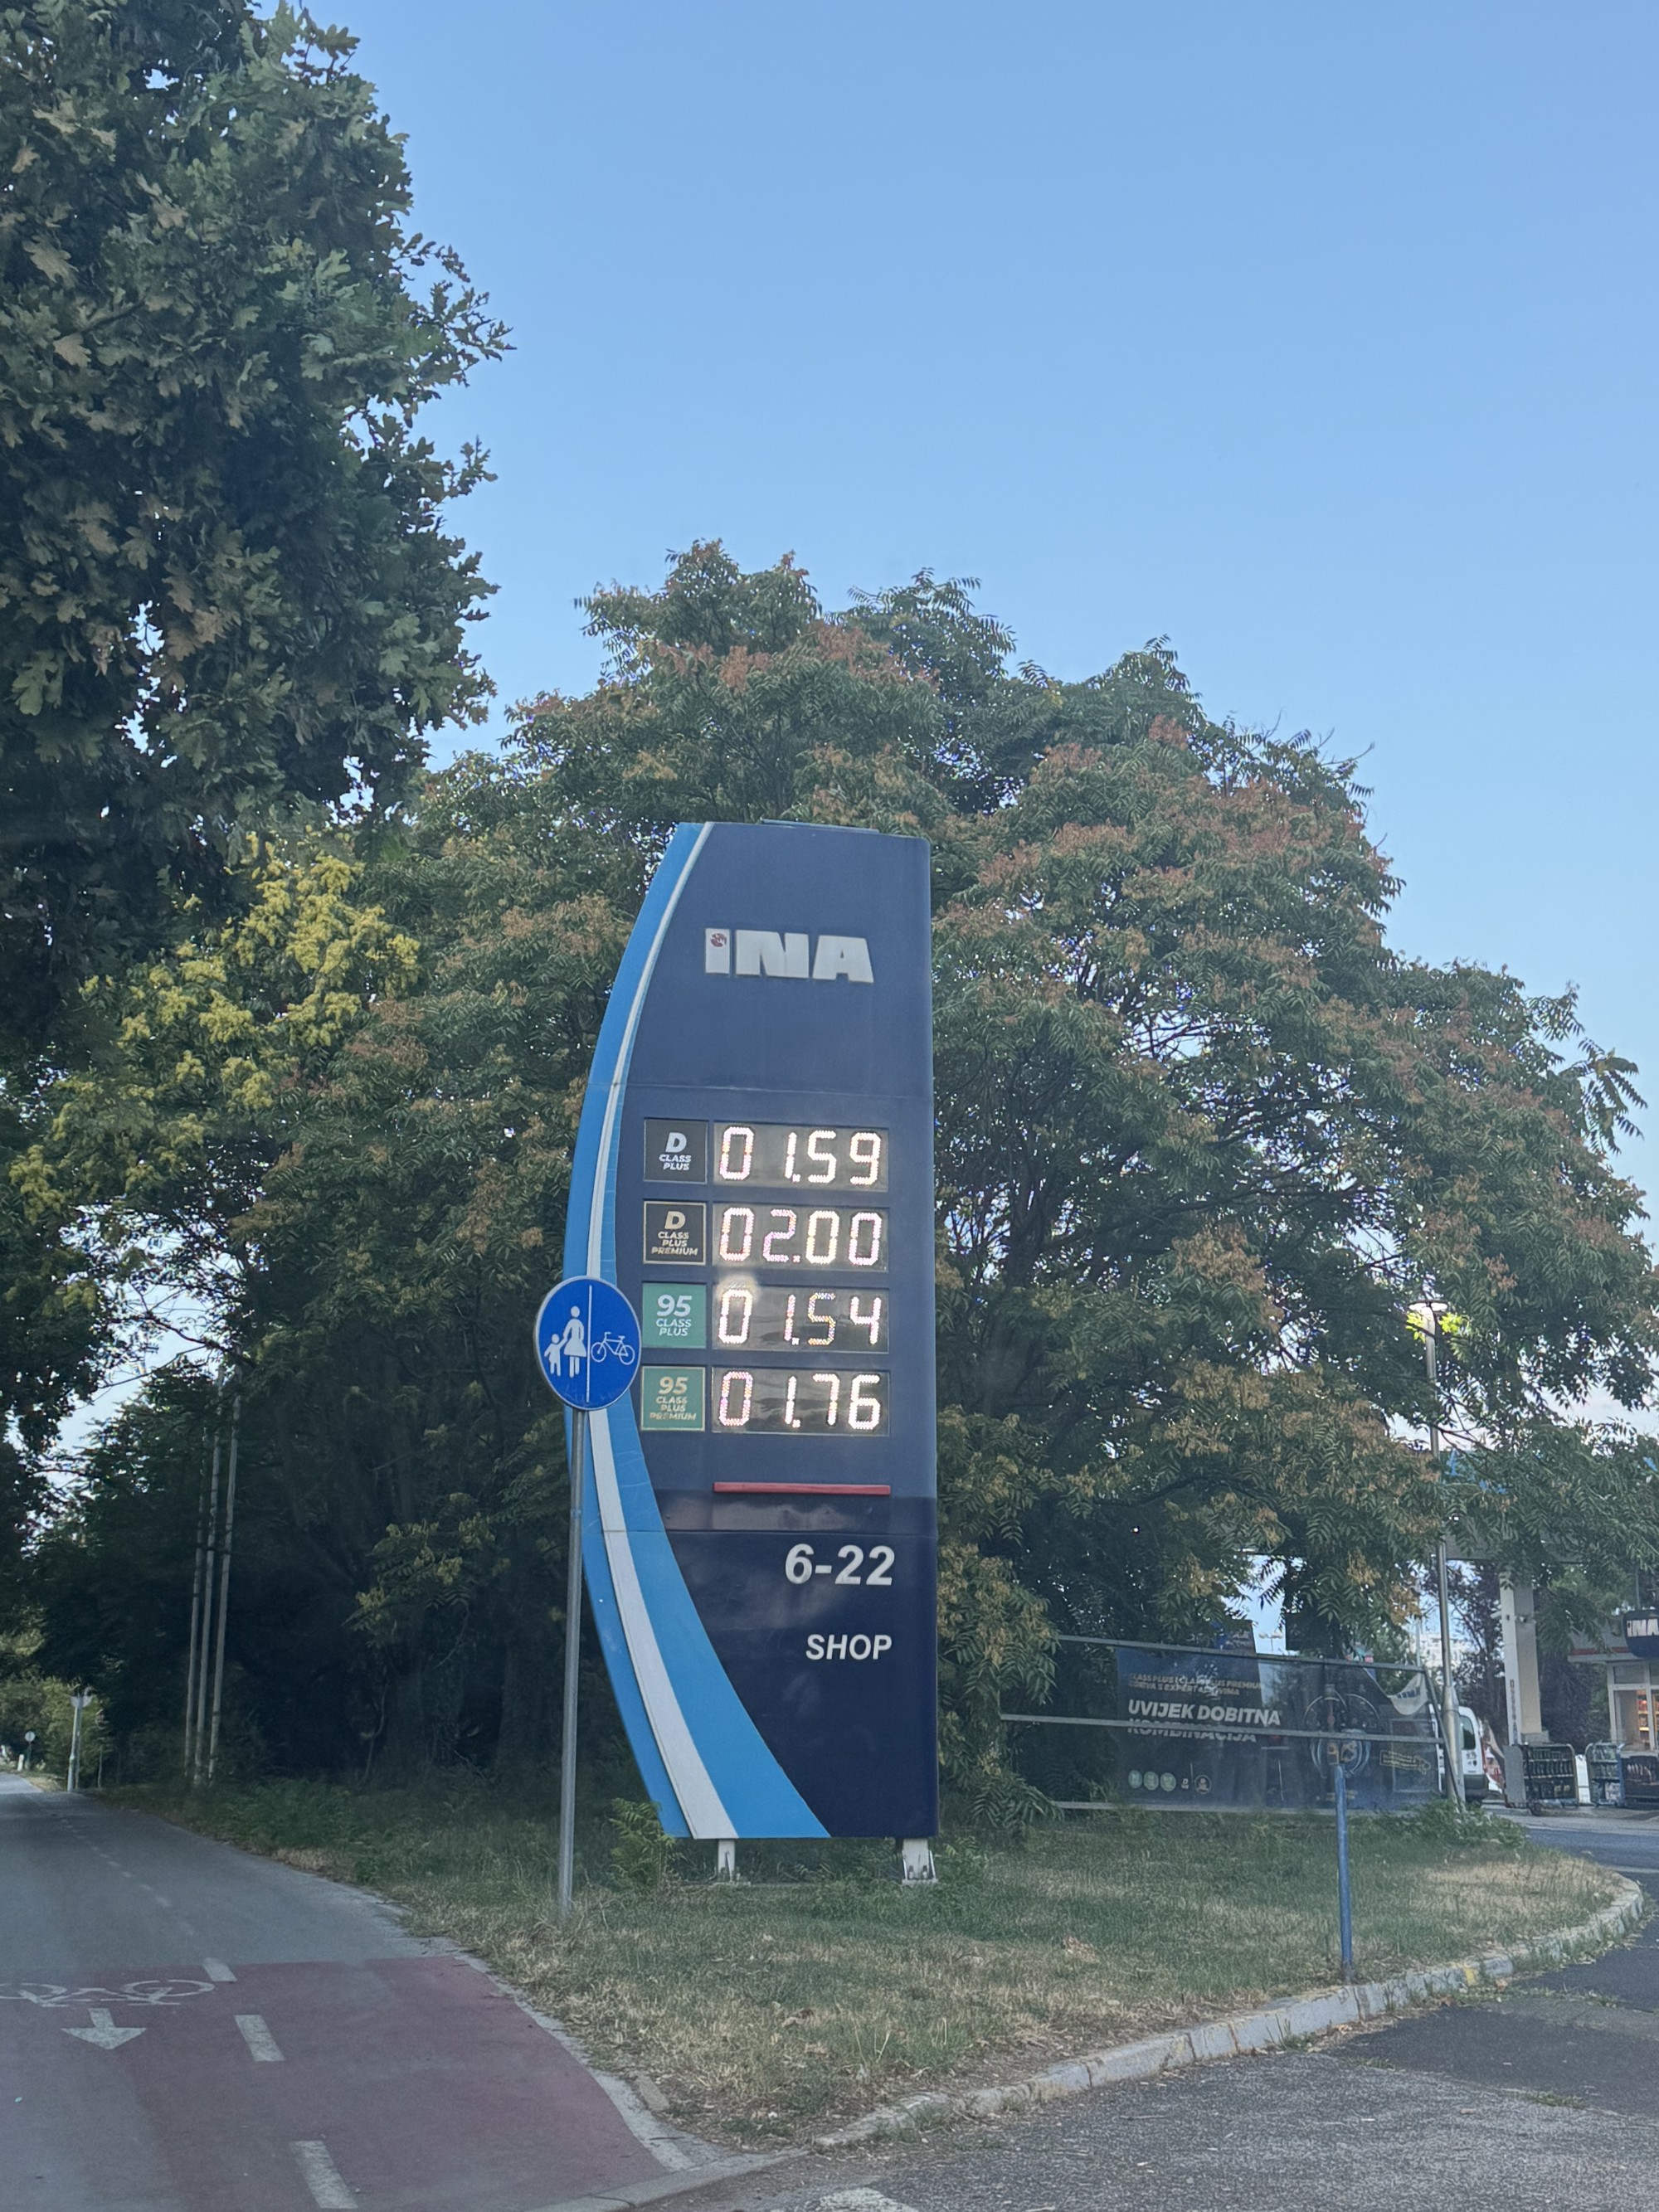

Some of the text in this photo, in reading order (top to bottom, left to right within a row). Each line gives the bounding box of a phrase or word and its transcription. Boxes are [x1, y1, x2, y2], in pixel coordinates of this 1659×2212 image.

[705, 927, 873, 983] INA
[665, 1132, 687, 1153] D
[659, 1154, 692, 1163] CLASS
[663, 1162, 689, 1171] PLUS
[664, 1211, 686, 1230] D
[658, 1232, 689, 1240] CLASS
[662, 1239, 687, 1247] PLUS
[651, 1247, 698, 1256] PREMIUM
[656, 1294, 693, 1317] 95
[656, 1318, 692, 1328] CLASS
[659, 1327, 688, 1336] PLUS
[658, 1376, 688, 1395] 95
[656, 1396, 688, 1404] CLASS
[661, 1403, 686, 1412] PLUS
[649, 1412, 697, 1421] PREMIUM
[785, 1544, 895, 1586] 6-22
[805, 1634, 893, 1660] SHOP
[1128, 1699, 1281, 1727] UVIJEK DOBITNA
